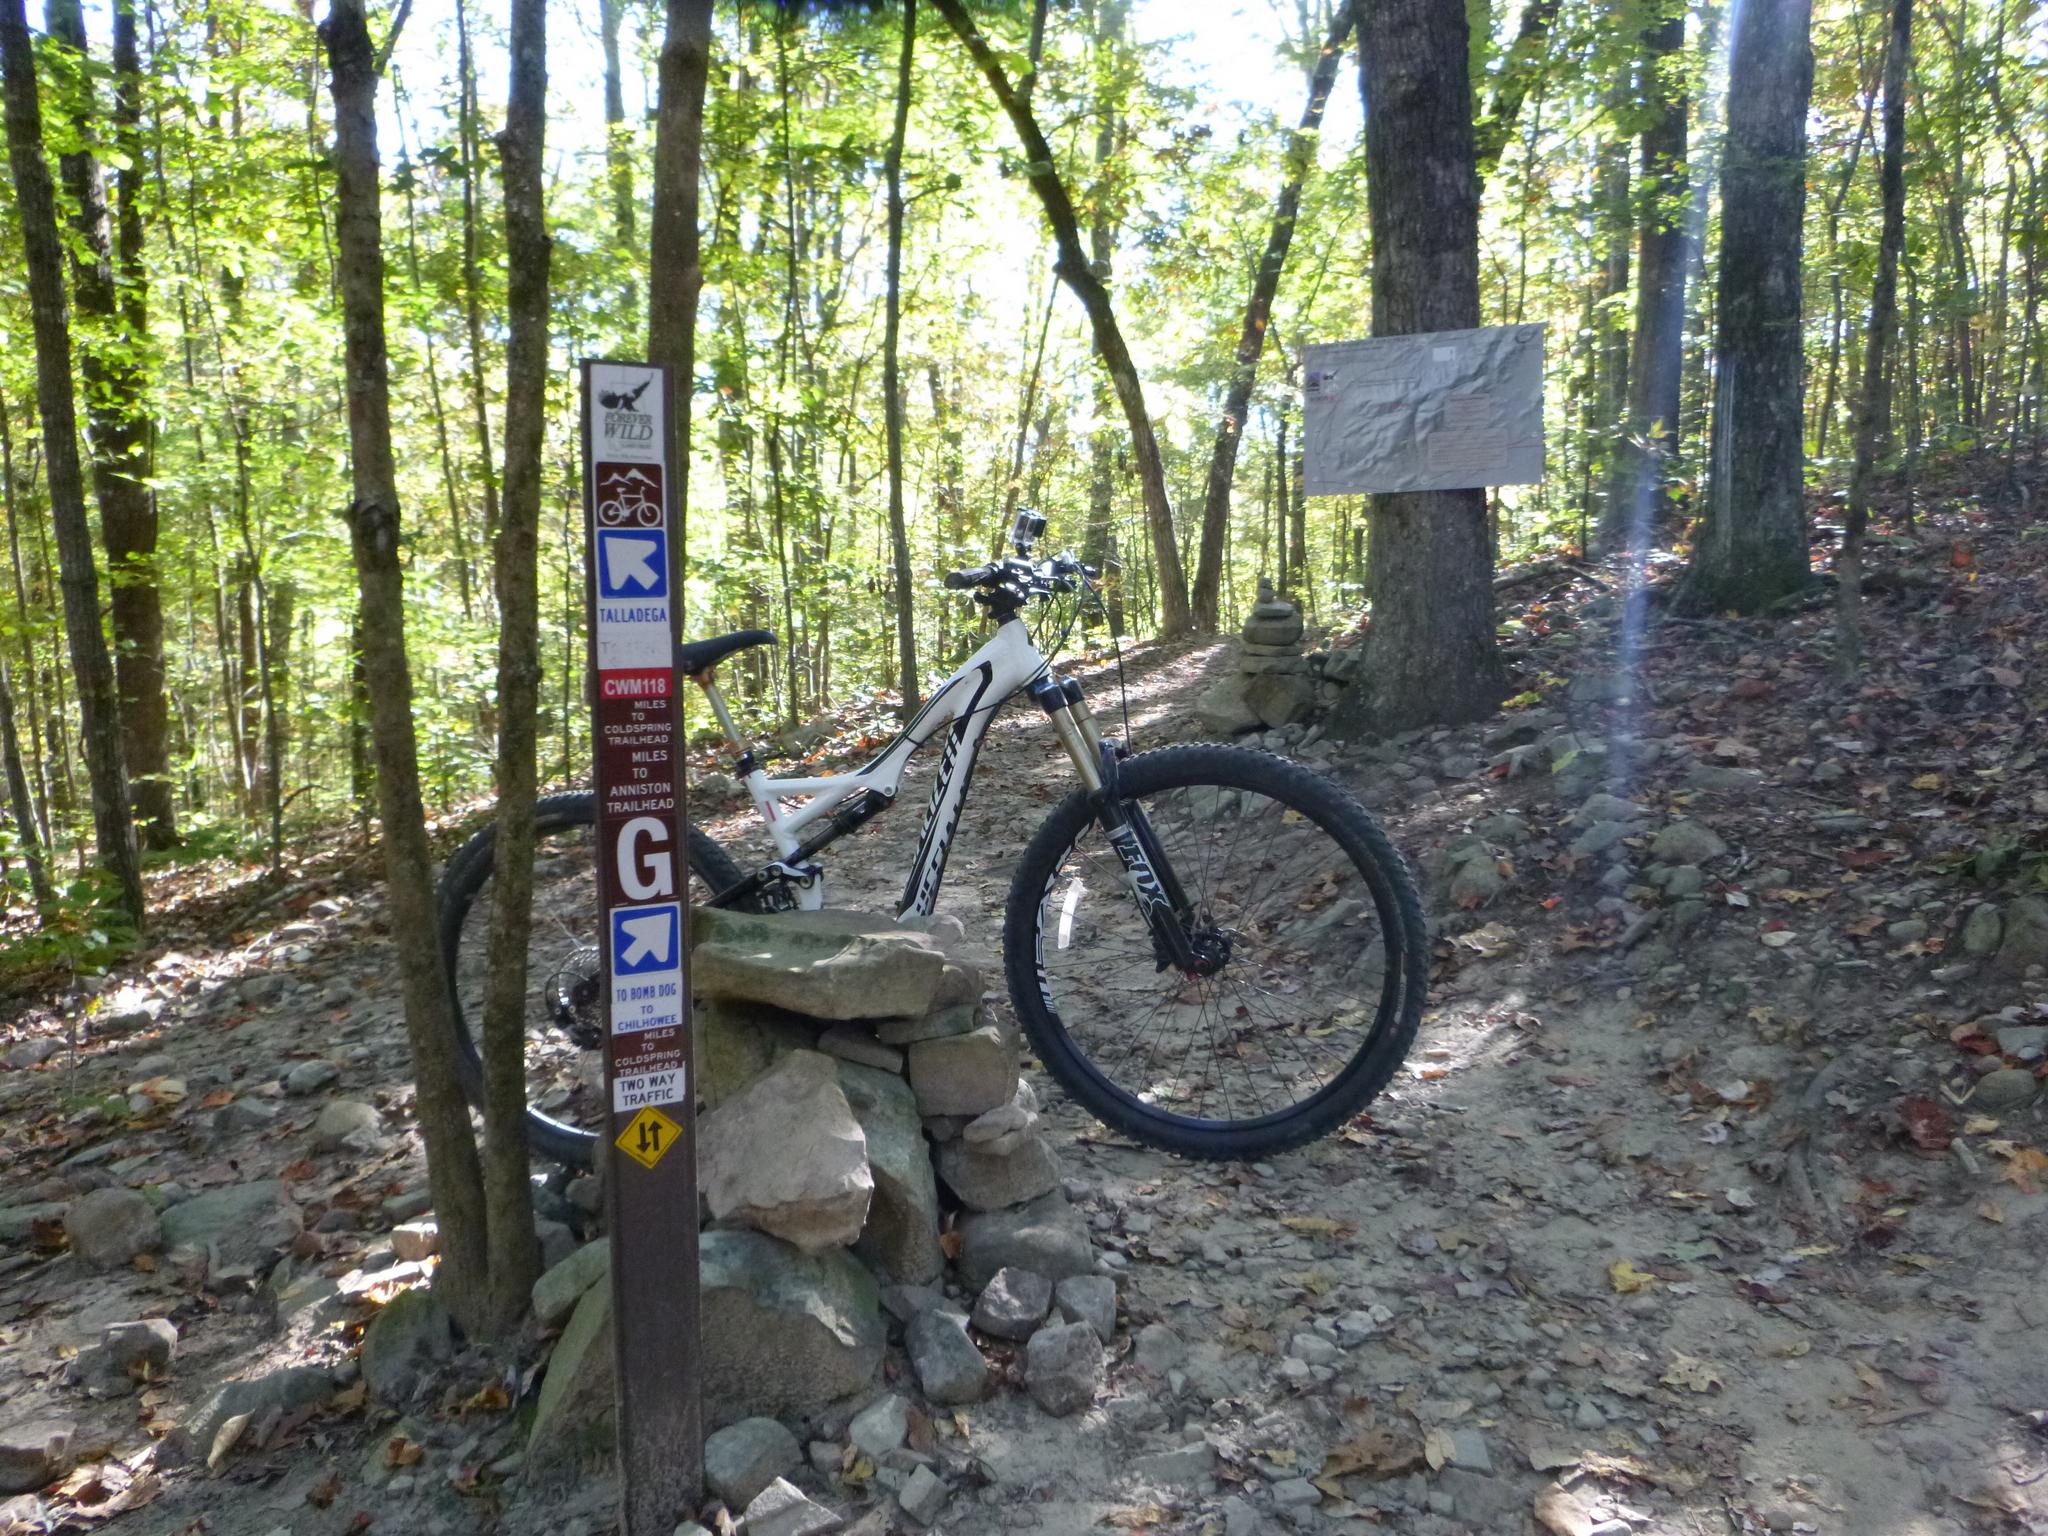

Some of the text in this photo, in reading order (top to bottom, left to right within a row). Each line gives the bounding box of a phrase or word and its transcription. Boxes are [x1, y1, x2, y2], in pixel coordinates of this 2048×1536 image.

[604, 423, 653, 440] WILD
[600, 608, 667, 622] TALLADEGA
[604, 679, 666, 695] CWM118
[634, 700, 666, 709] MILES
[631, 712, 645, 720] TO
[604, 723, 672, 734] COLDSPRING
[608, 735, 669, 746] TRAILHEAD
[632, 750, 668, 762] MILES
[632, 767, 648, 779] TO
[610, 782, 671, 797] ANNISTON
[607, 798, 674, 813] TRAILHEAD
[617, 816, 673, 900] G
[1116, 843, 1170, 914] FOX
[616, 983, 677, 1002] TO BOMB DOG
[640, 1004, 654, 1014] TO
[618, 1014, 677, 1031] CHILHOWEE
[644, 1028, 676, 1040] MILES
[640, 1043, 654, 1052] TO
[615, 1049, 680, 1067] COLDSPRING
[619, 1060, 678, 1077] TRAILHEAD
[620, 1073, 676, 1092] TWO WAY
[623, 1088, 673, 1106] TRAFFIC
